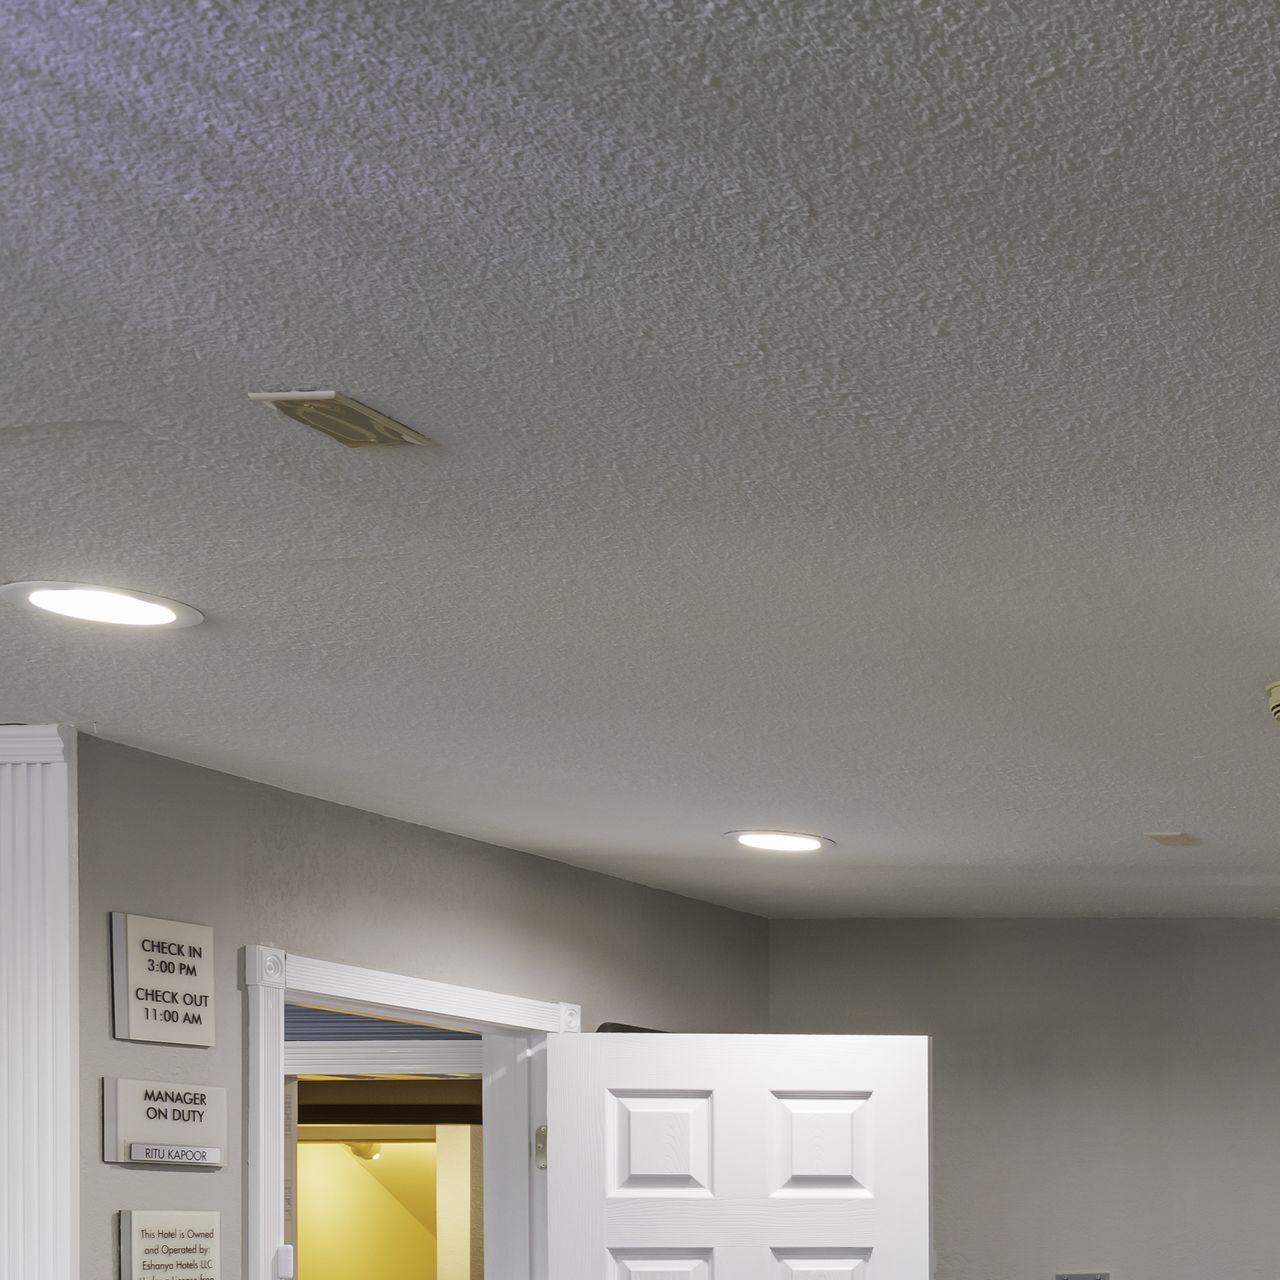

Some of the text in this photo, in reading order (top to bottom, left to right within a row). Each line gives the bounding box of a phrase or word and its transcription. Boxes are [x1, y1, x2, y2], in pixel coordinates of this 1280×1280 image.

[141, 939, 202, 958] CHECK IN
[148, 959, 197, 976] 3:00 PM
[135, 987, 209, 1007] CHECK OUT
[144, 1008, 202, 1025] 11:00 AM
[144, 1089, 207, 1105] MANAGER
[146, 1107, 205, 1122] ON DUTY
[145, 1148, 207, 1161] RITU KAPOOR
[140, 1229, 214, 1239] This Hotel is Owned
[144, 1244, 159, 1254] and
[161, 1244, 197, 1256] Operated
[142, 1260, 213, 1272] Eshanya Hotels LLC
